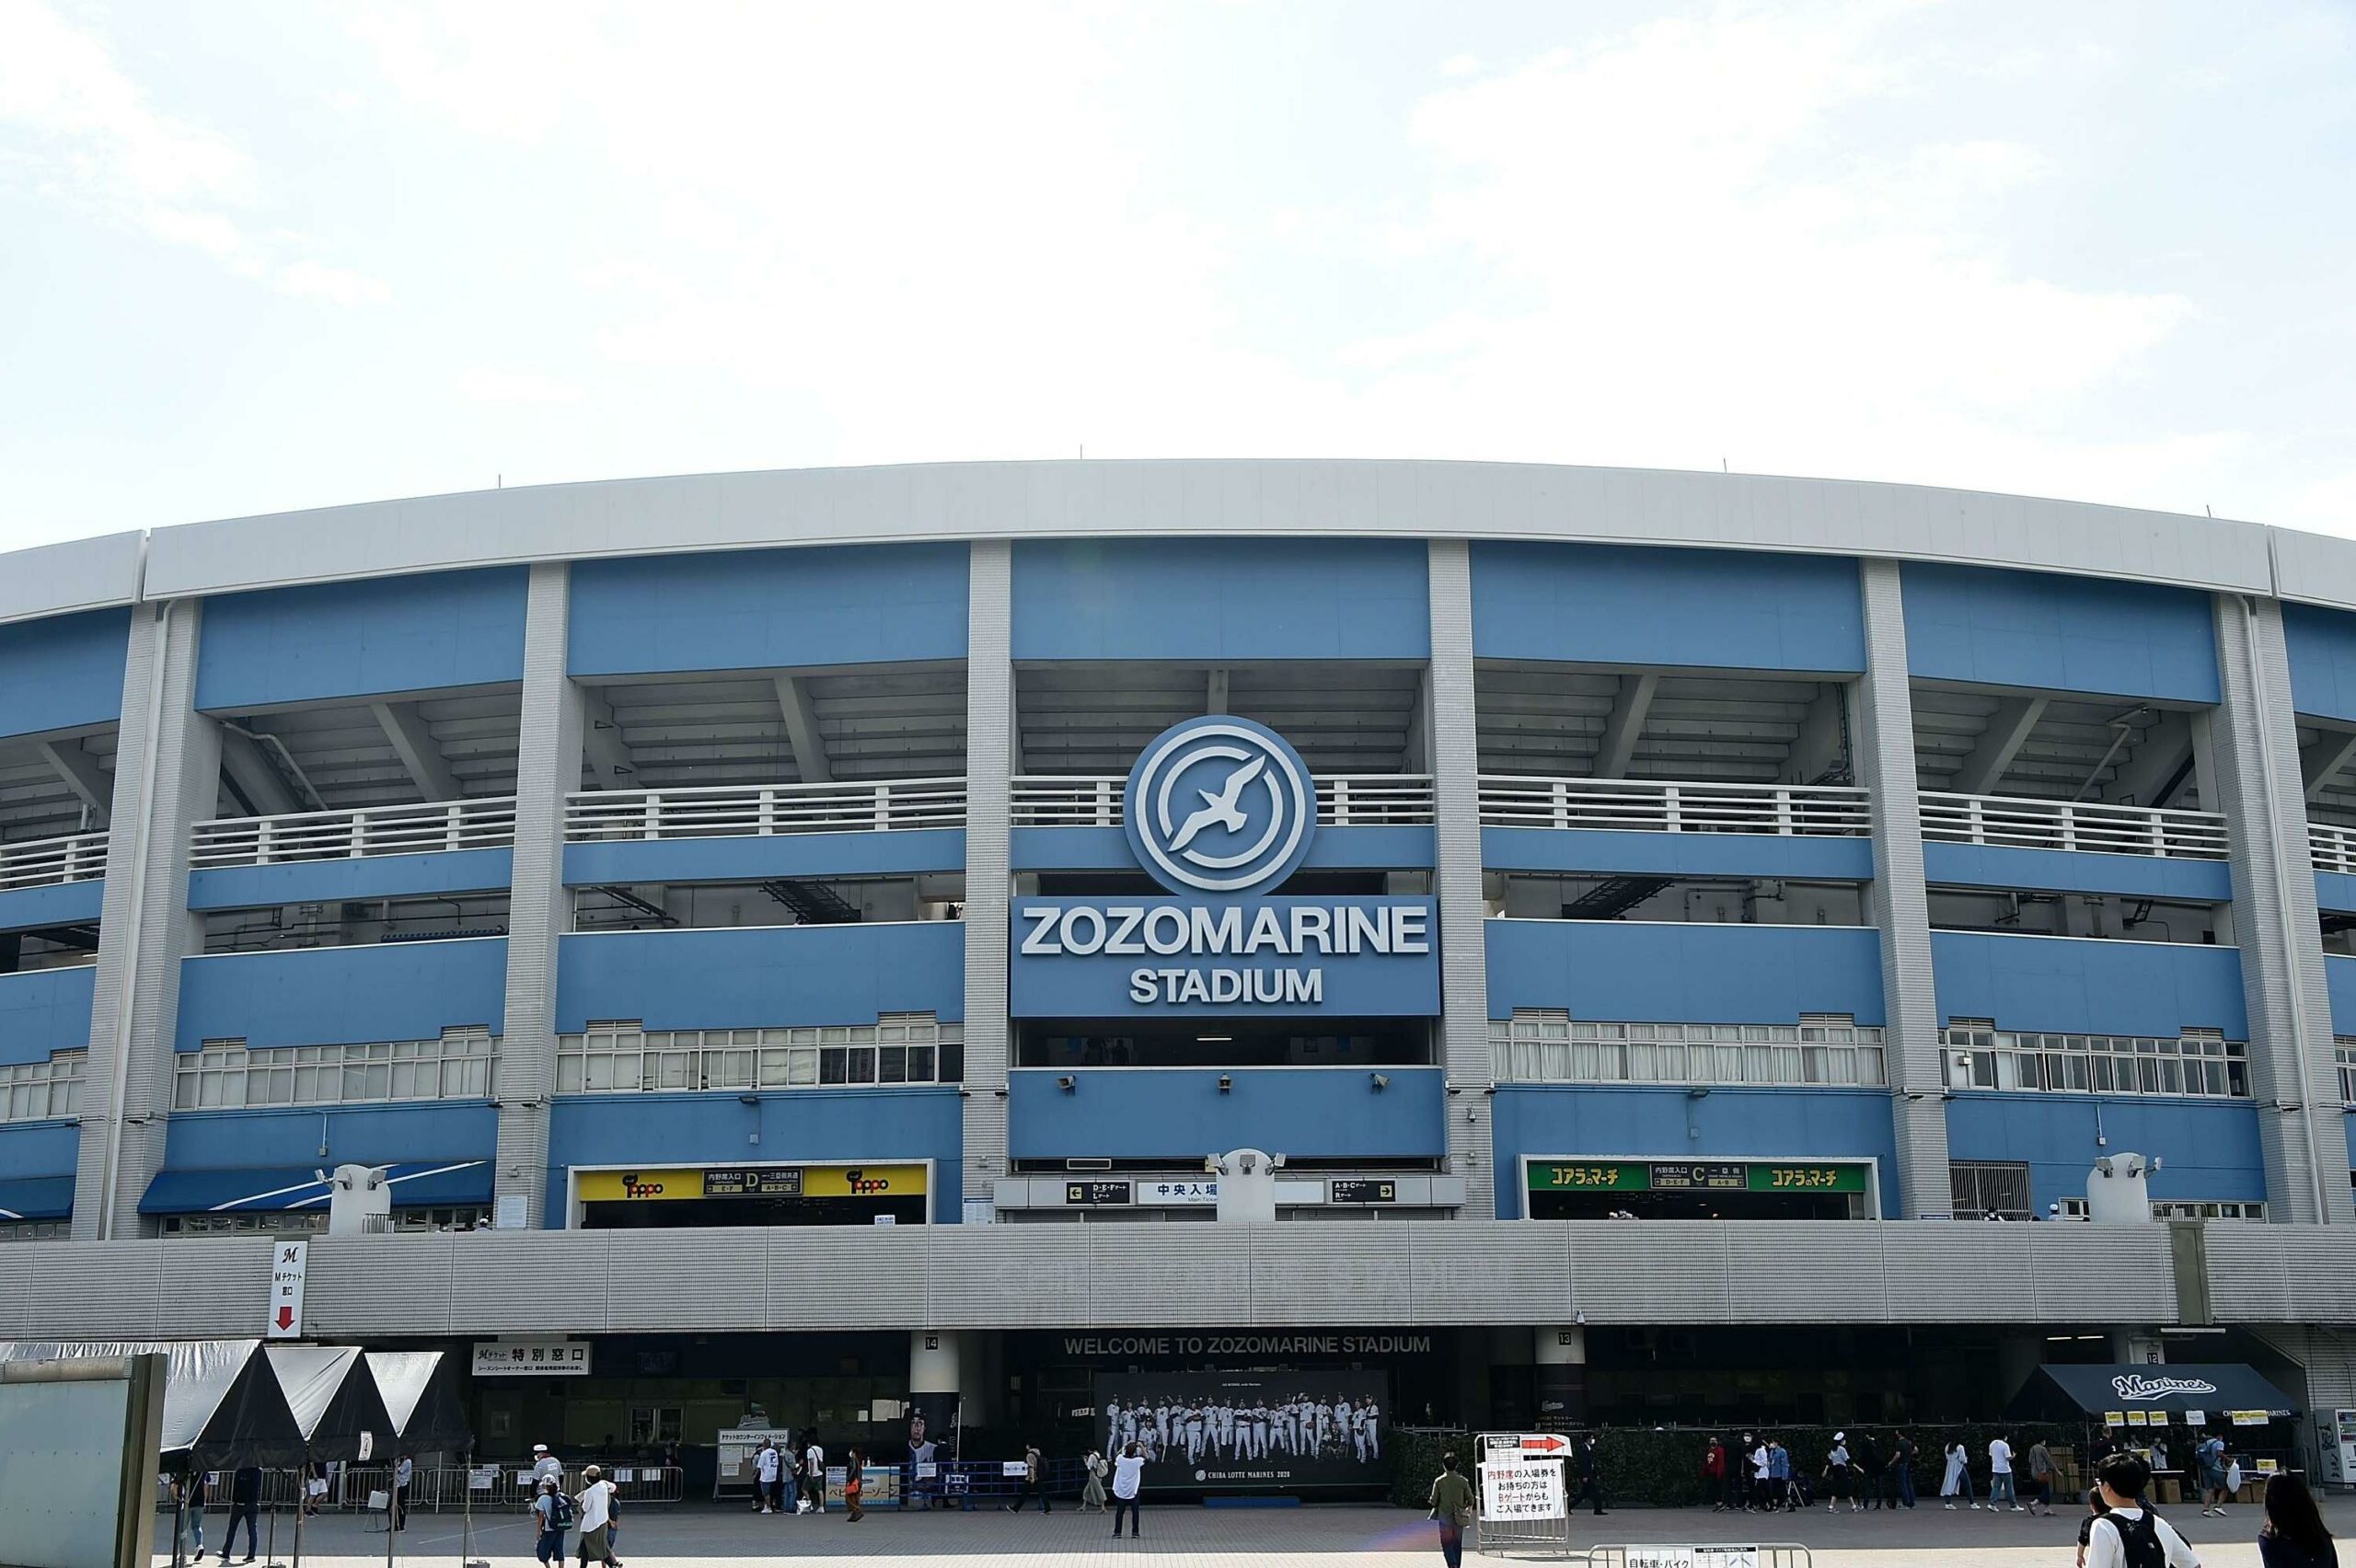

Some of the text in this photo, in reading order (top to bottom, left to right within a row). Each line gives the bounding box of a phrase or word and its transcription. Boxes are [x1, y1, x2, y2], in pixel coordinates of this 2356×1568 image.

[1021, 906, 1430, 955] ZOZOMARINE
[1129, 969, 1322, 1003] STADIUM
[745, 1172, 758, 1187] D
[1552, 1168, 1618, 1184] コアラのマーチ
[1692, 1167, 1705, 1182] C
[1772, 1170, 1837, 1186] コアラのマーチ
[274, 1272, 302, 1282] Mチケット
[927, 1338, 938, 1348] 14
[1559, 1333, 1571, 1343] 13
[1065, 1336, 1430, 1355] WELCOME TO ZOZOMARINE STADIUM
[512, 1348, 584, 1362] 特別窓口
[2147, 1353, 2158, 1364] 12
[2112, 1375, 2216, 1400] Marines
[1488, 1470, 1556, 1480] 内野席の入場券を
[1498, 1482, 1547, 1491] お持ちの方は
[1496, 1504, 1553, 1513] ご入場できます
